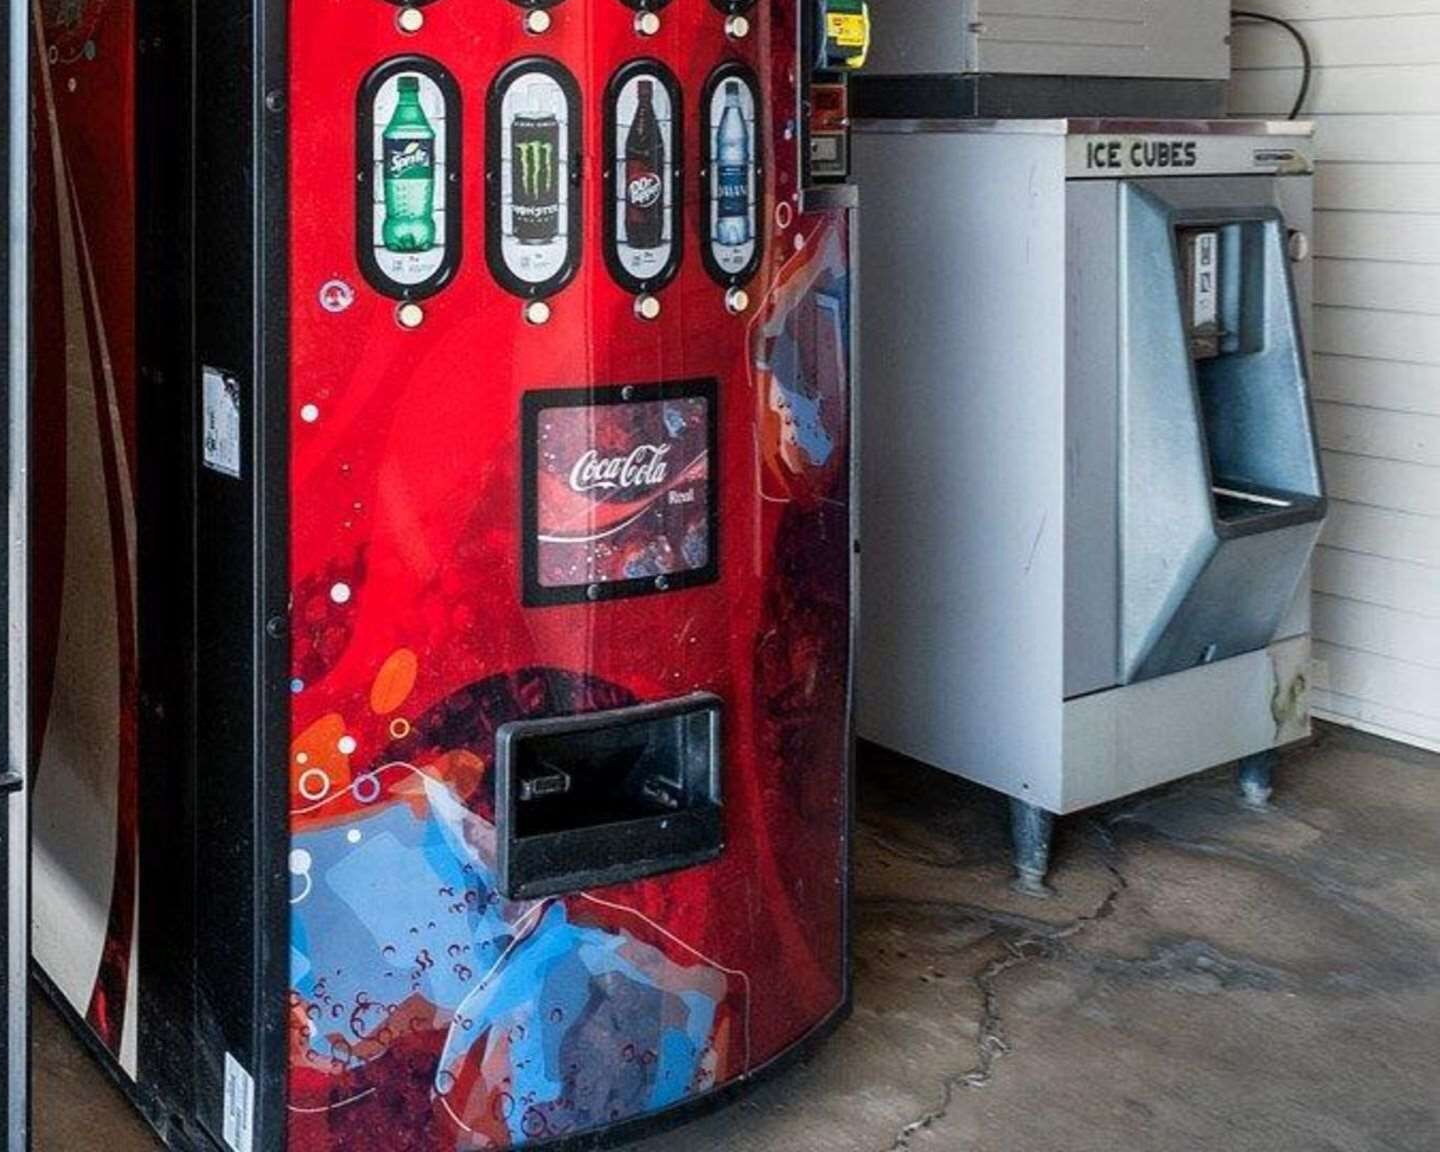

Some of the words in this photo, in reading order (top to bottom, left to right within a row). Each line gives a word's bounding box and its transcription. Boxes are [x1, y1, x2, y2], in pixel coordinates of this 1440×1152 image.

[1086, 142, 1122, 169] ICE
[1130, 141, 1197, 168] CUBES
[569, 442, 672, 492] Coca-Cola
